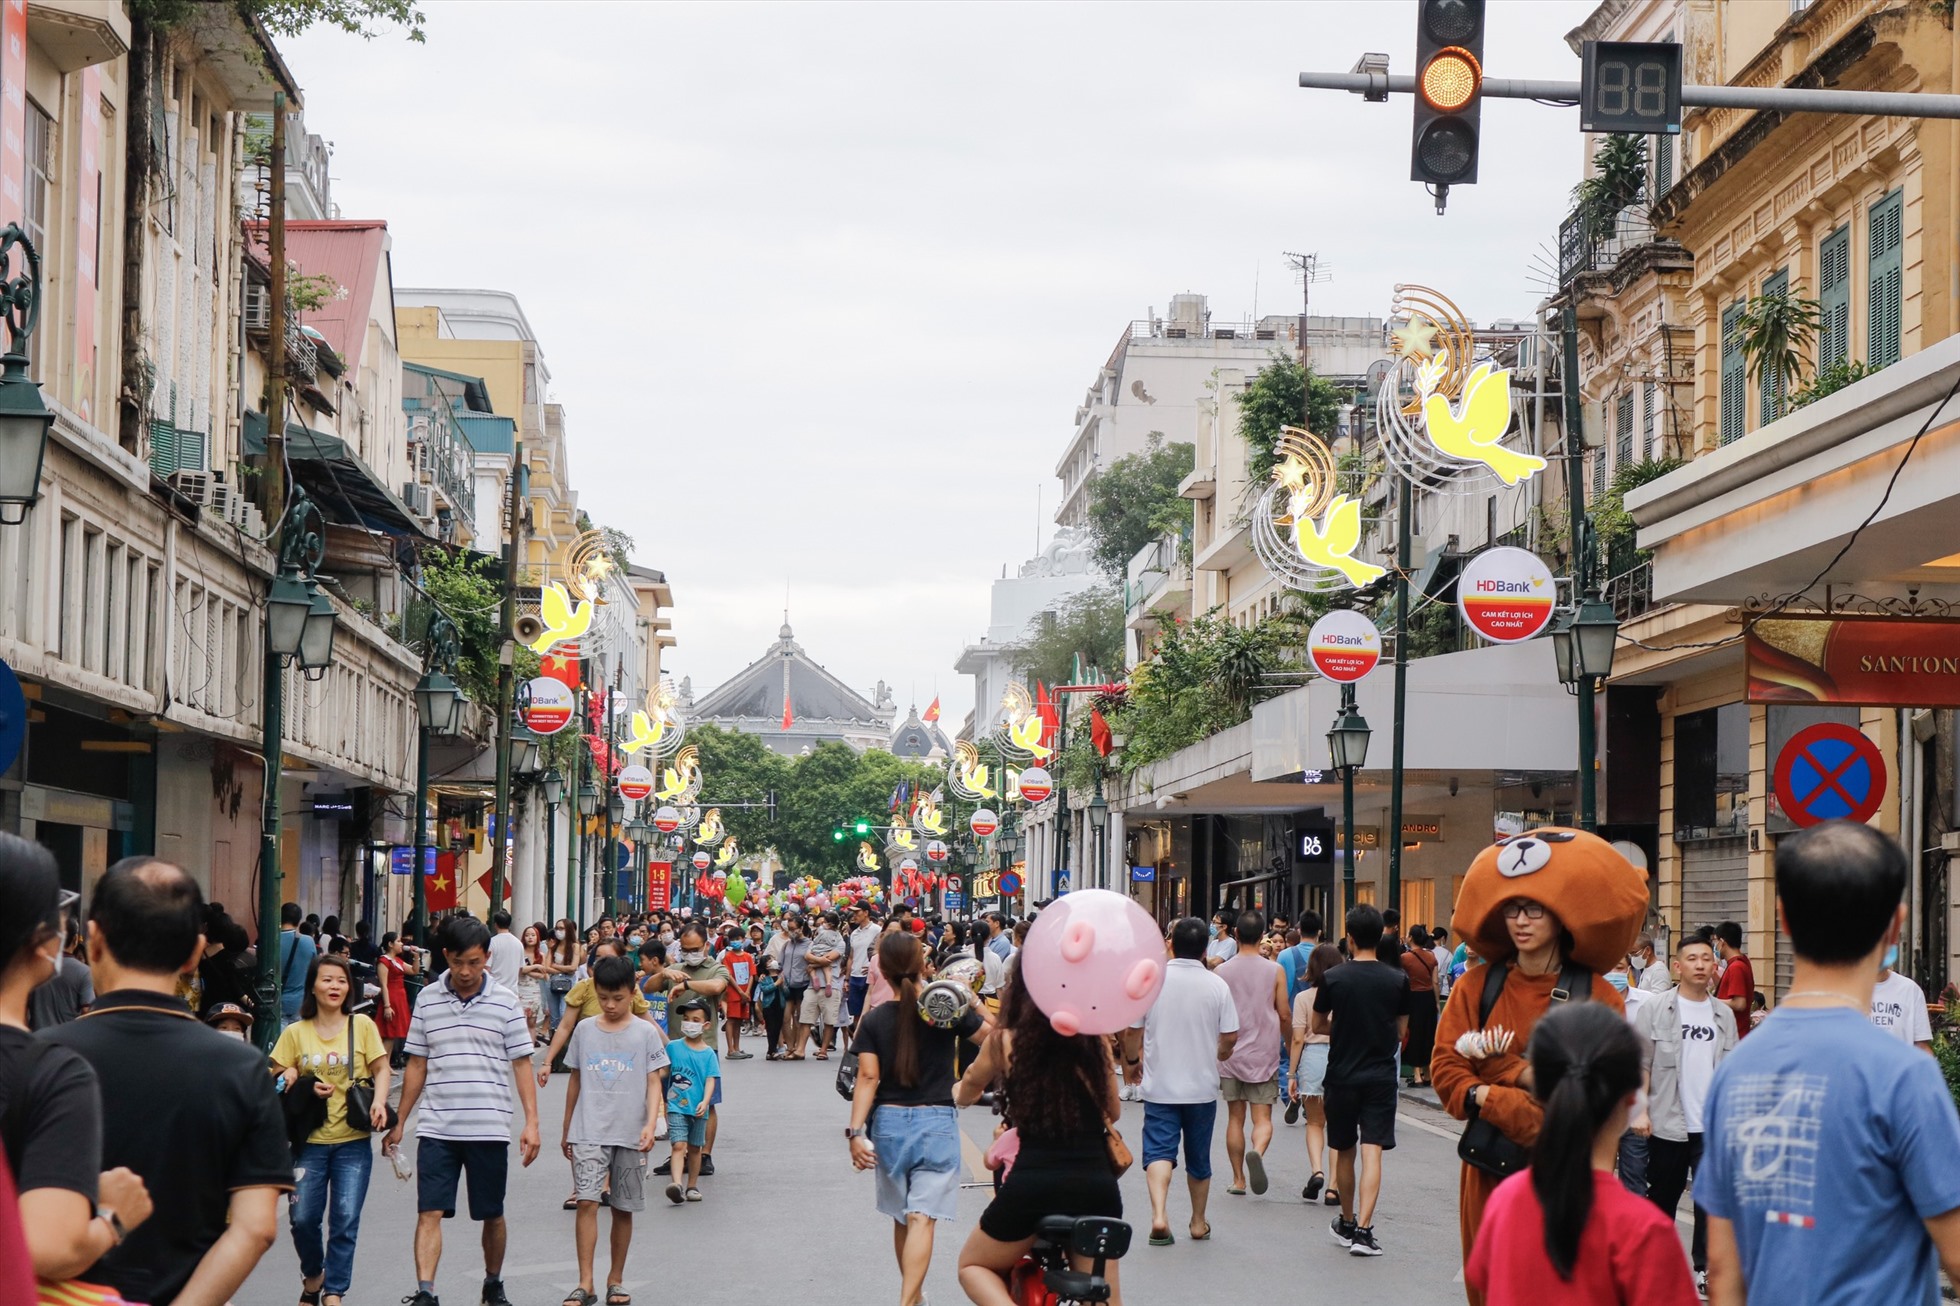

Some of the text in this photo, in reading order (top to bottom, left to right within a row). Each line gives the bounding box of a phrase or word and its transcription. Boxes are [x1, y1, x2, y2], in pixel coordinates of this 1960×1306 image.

[1476, 580, 1530, 593] HDBank
[1497, 610, 1509, 618] KẾT
[1522, 611, 1533, 619] ÍCH
[1506, 620, 1524, 628] NHẤT
[1322, 634, 1362, 645] HDBank
[1401, 824, 1438, 833] ANDRO
[1682, 1024, 1715, 1042] 789
